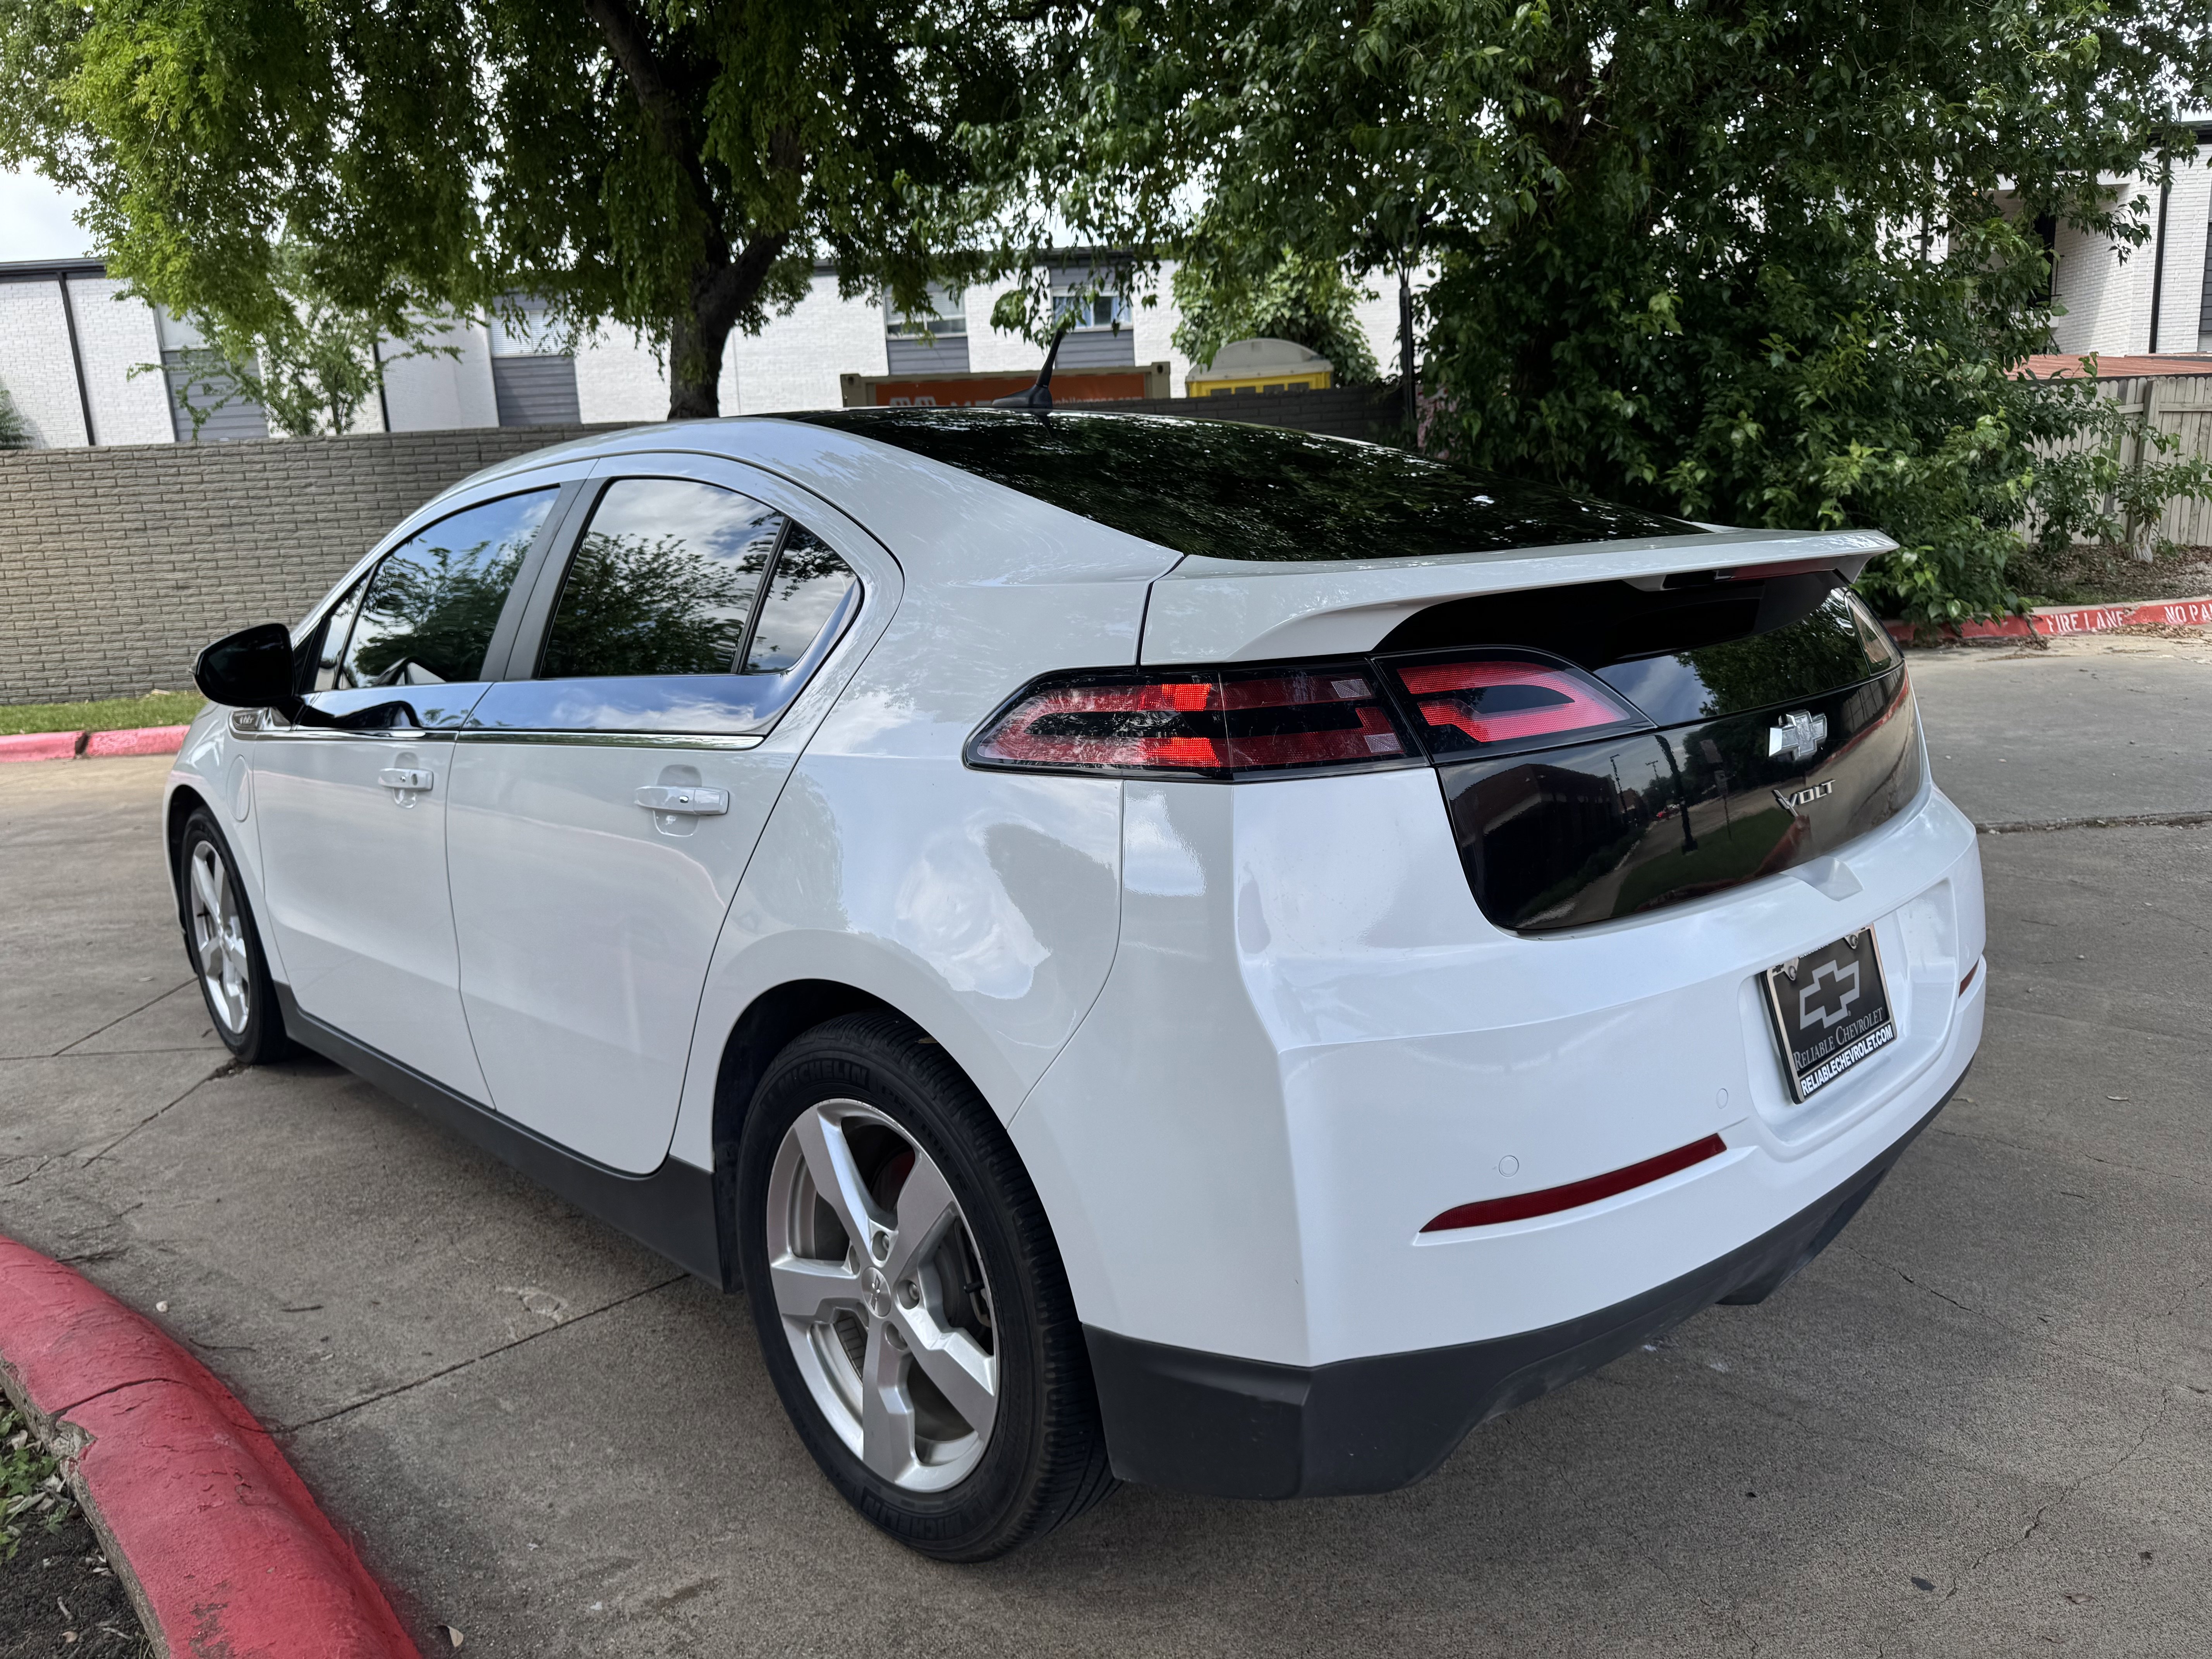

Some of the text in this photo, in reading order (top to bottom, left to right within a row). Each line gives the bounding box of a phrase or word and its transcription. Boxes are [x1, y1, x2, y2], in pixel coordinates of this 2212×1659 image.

[2046, 613, 2082, 632] FIRE
[2084, 610, 2124, 632] LANE
[2164, 606, 2187, 624] NO
[1771, 778, 1836, 817] VOLT
[1793, 1007, 1883, 1072] RELIABLE CHEVROLET
[778, 1059, 868, 1099] MICHELIN
[1801, 1024, 1893, 1096] RELIABLECHEVROLET.COM
